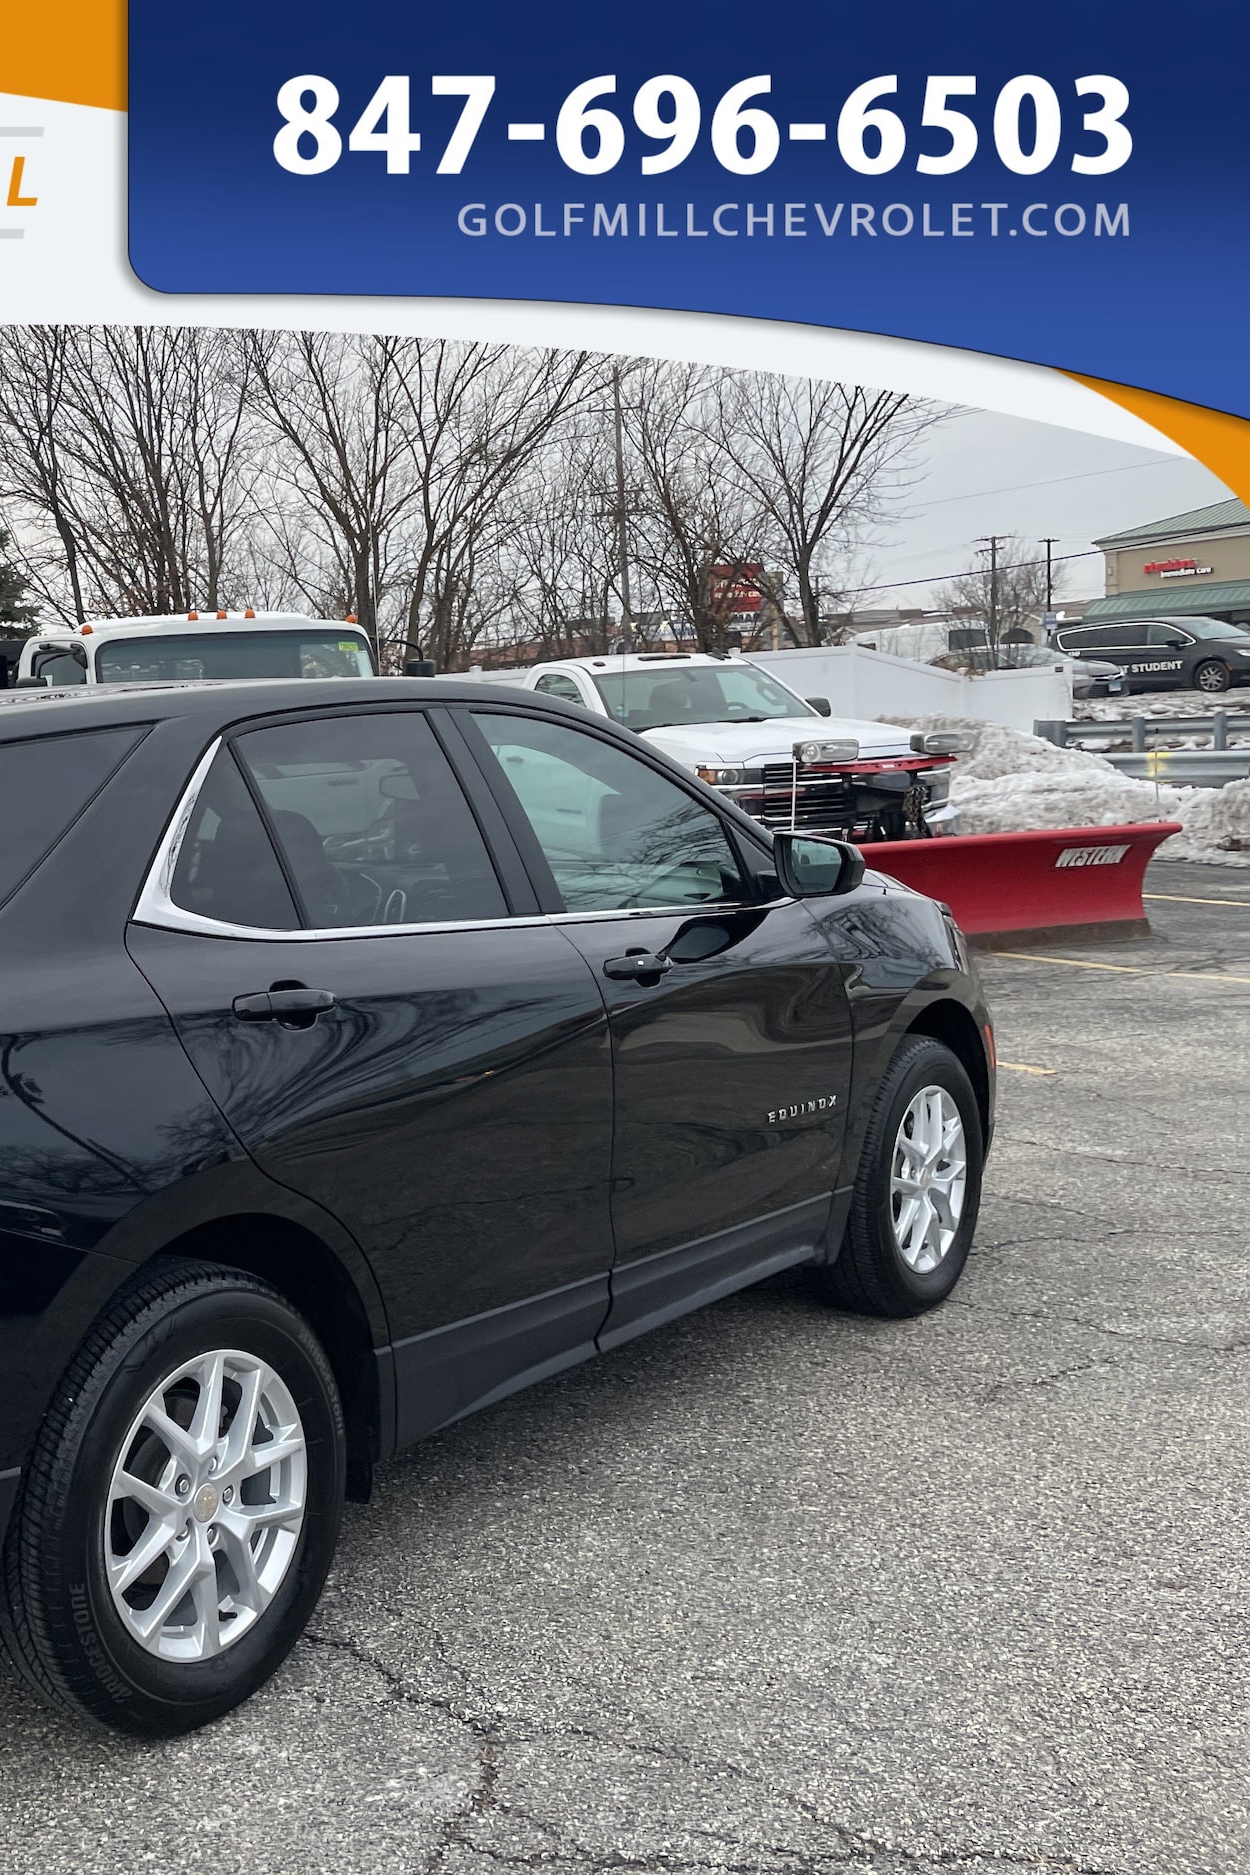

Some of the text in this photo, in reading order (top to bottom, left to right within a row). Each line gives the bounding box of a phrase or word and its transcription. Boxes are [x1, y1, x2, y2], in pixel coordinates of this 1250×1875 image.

[1131, 660, 1183, 673] STUDENT
[1054, 844, 1132, 868] WESTERN
[768, 1094, 837, 1124] EQUINOX
